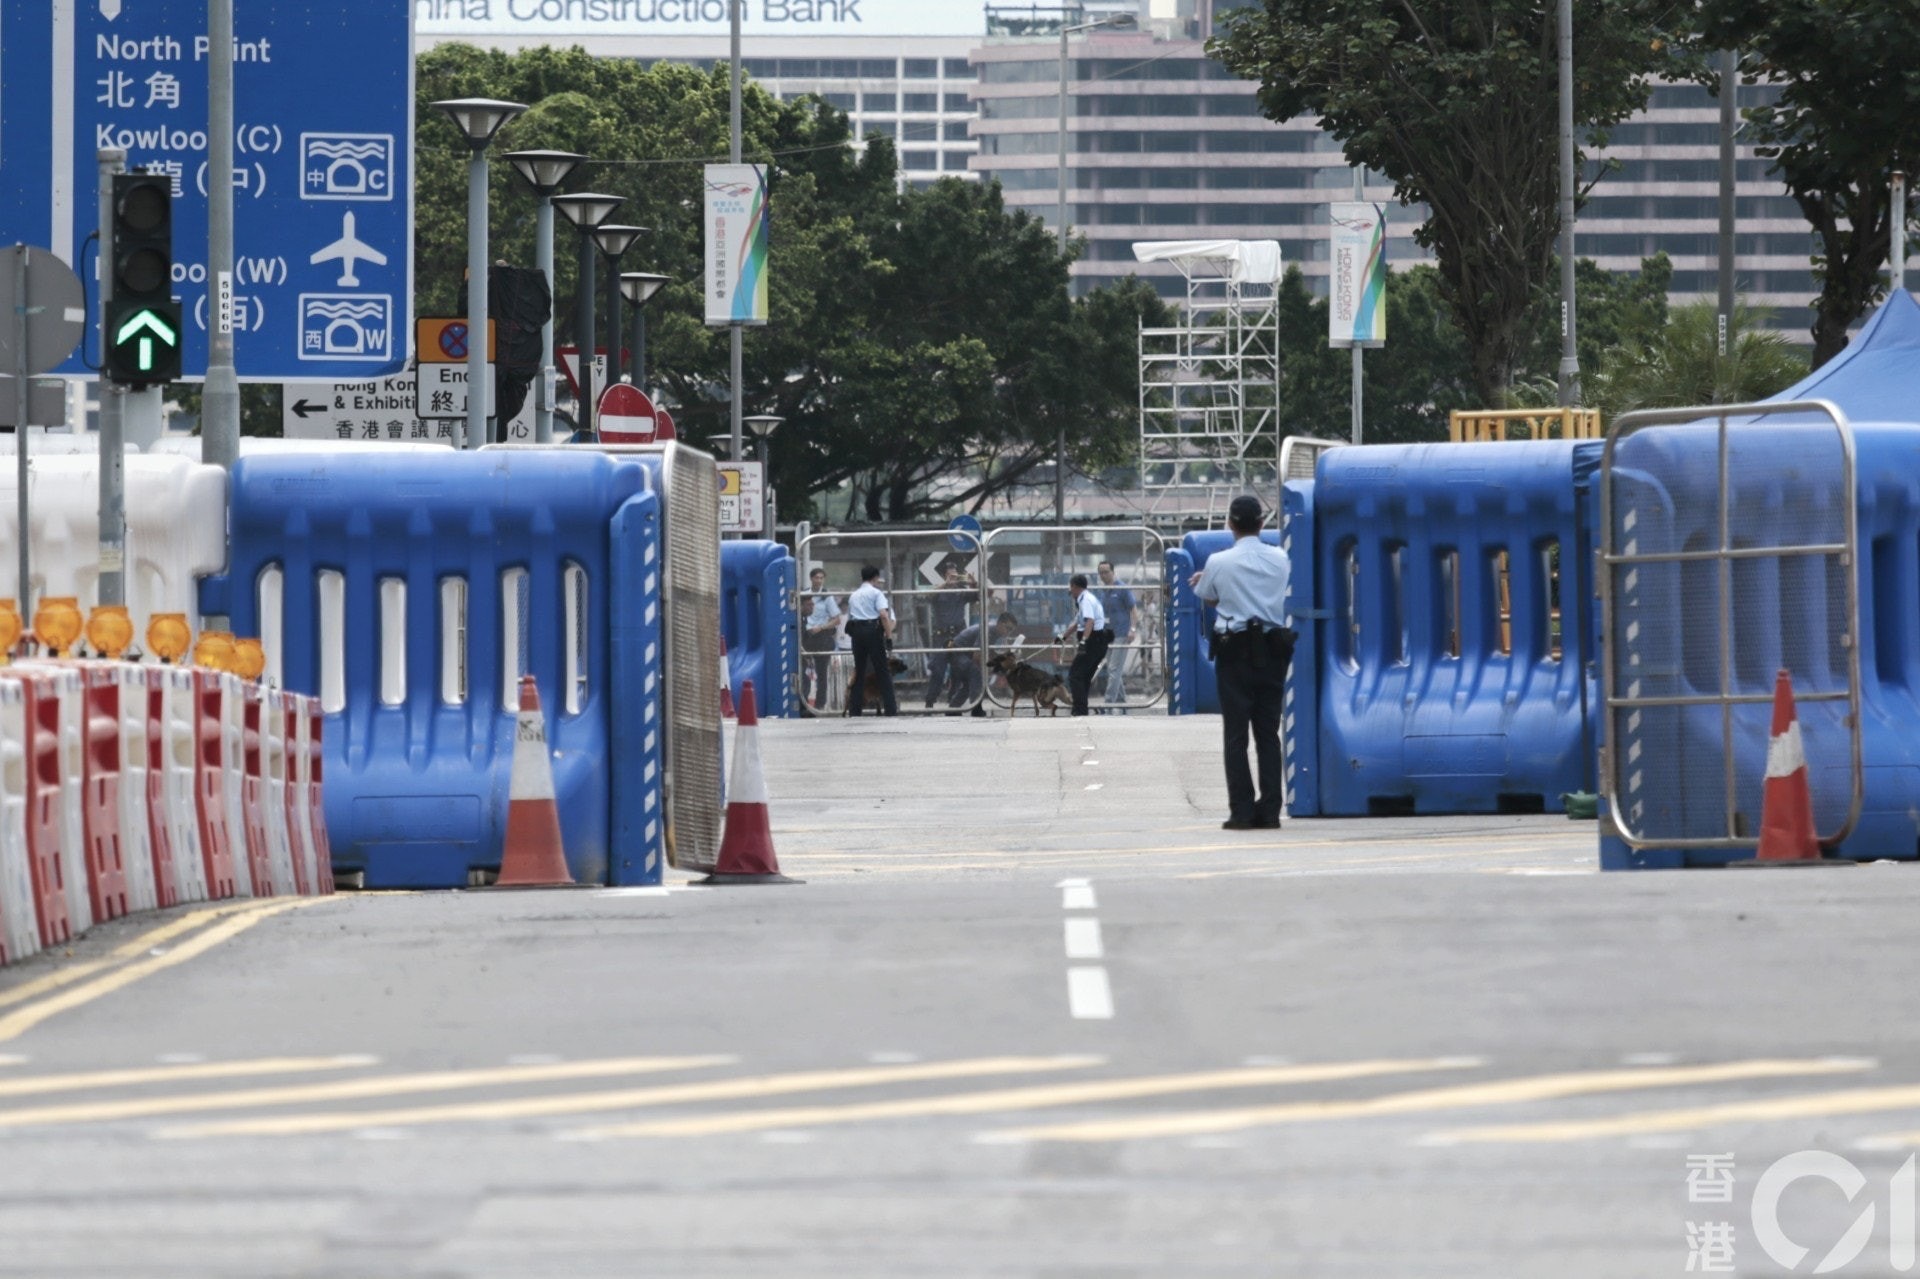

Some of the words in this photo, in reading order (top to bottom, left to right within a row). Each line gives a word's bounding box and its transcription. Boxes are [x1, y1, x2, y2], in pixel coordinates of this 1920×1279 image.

[507, 0, 748, 22] Construction
[763, 0, 863, 22] Bank
[97, 34, 181, 61] North
[194, 36, 271, 63] Pint
[96, 71, 180, 109] 北角
[96, 124, 207, 150] Kowloo
[237, 123, 282, 154] (C)
[307, 168, 324, 188] 中
[368, 169, 386, 190] C
[236, 255, 287, 286] (W)
[1343, 247, 1352, 284] HONG
[221, 280, 230, 332] 50660
[1343, 285, 1352, 321] KONG
[305, 330, 322, 350] 西
[365, 328, 385, 350] W
[384, 378, 415, 392] Kon
[335, 395, 346, 410] &
[354, 395, 415, 410] Exhibiti
